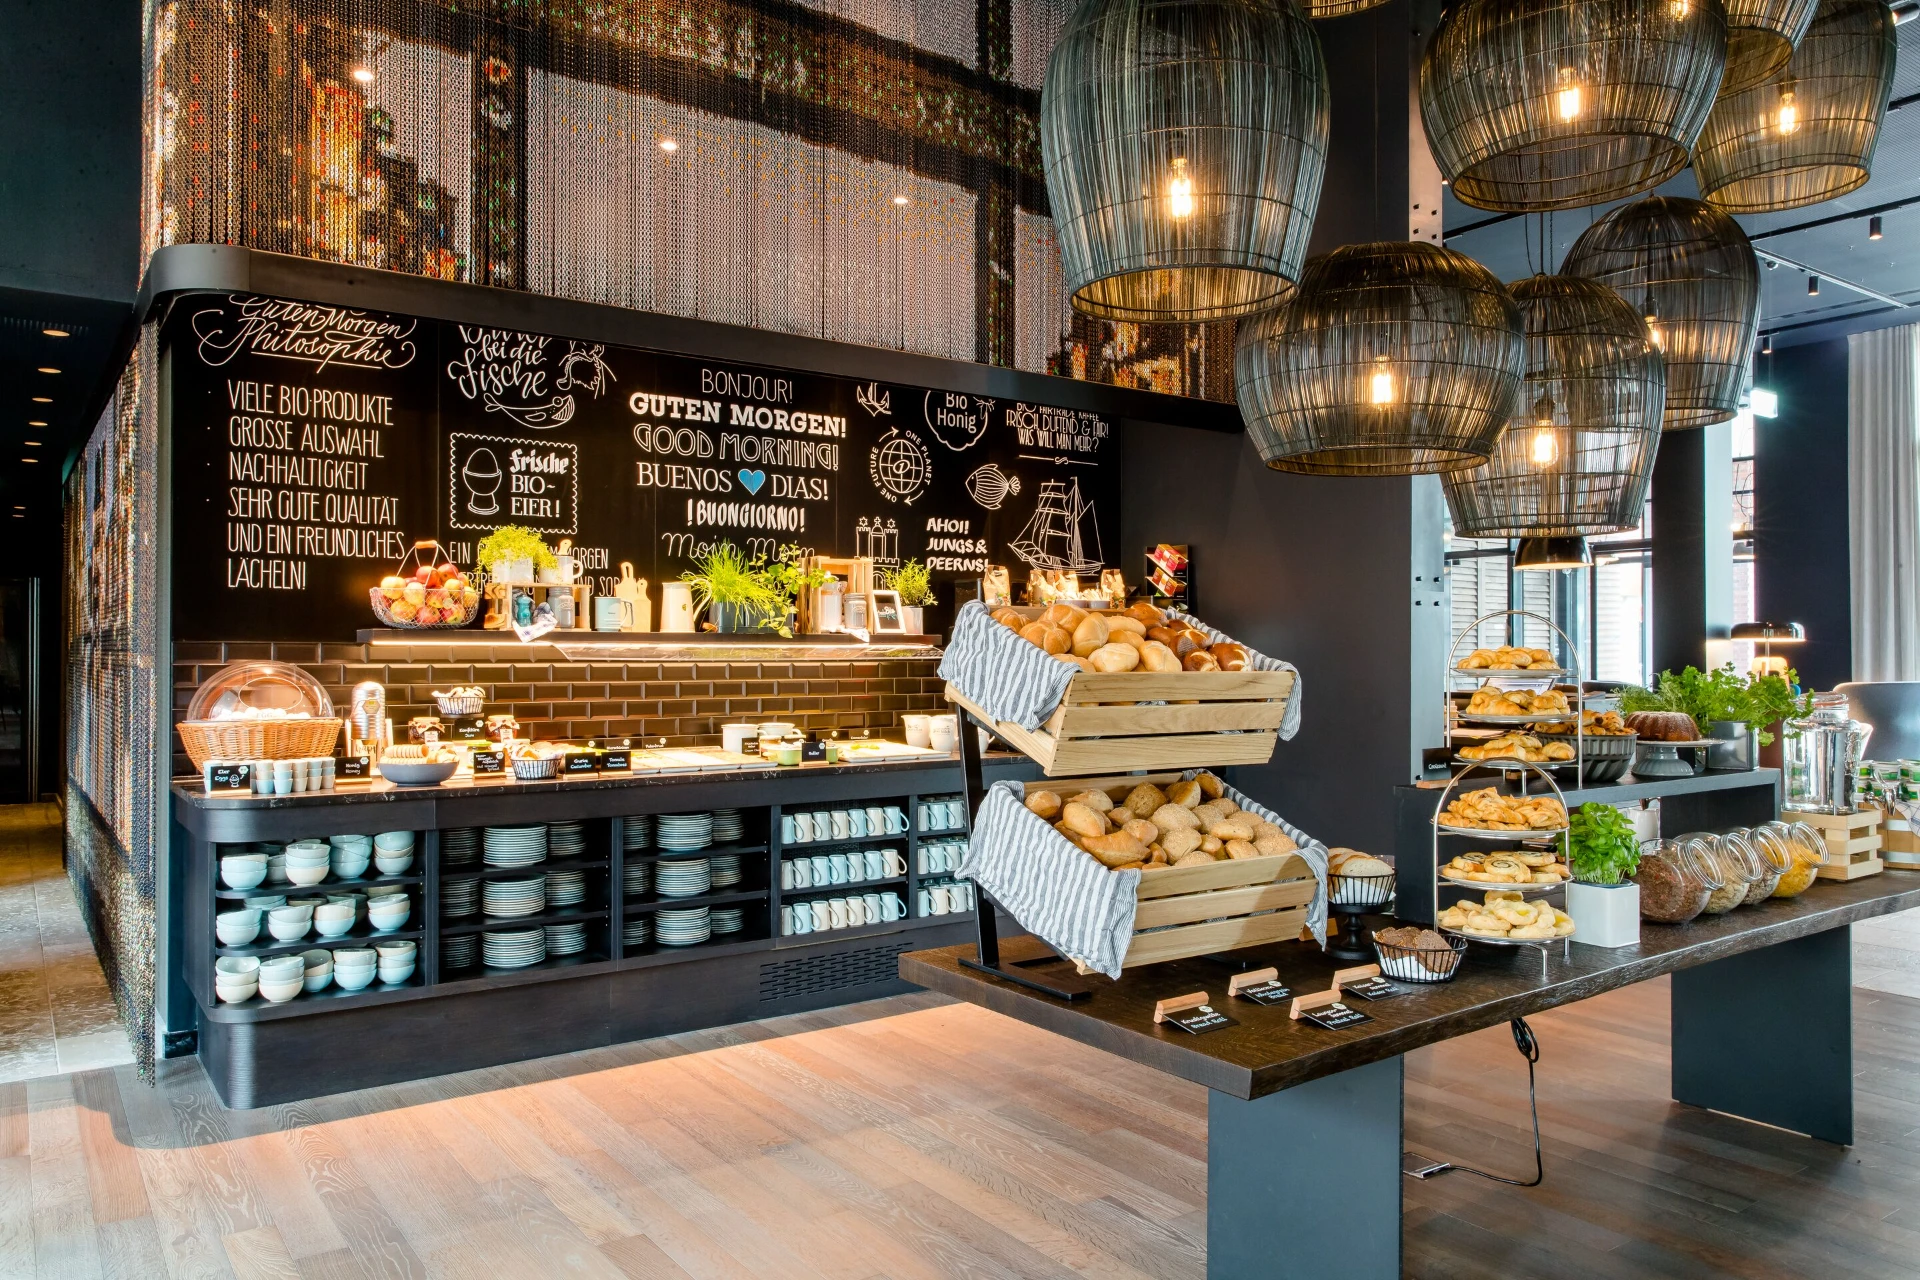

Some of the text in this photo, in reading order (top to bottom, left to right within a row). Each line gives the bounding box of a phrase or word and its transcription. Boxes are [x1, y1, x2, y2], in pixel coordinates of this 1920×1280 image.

[237, 296, 408, 340] Guten Morgen
[218, 313, 405, 374] Philosophie
[477, 334, 507, 361] bei
[509, 341, 547, 365] die
[447, 347, 548, 400] Fische
[701, 368, 793, 404] BONJOUR!
[227, 378, 275, 414] VIELE
[629, 391, 847, 438] GUTEN MORGEN!
[229, 415, 385, 459] GROSSE AUSWAHL
[937, 407, 977, 434] Honig
[1016, 427, 1035, 446] WAS
[1036, 430, 1055, 449] WILL
[1042, 414, 1079, 435] DUFTEND
[1081, 420, 1091, 436] &
[1092, 421, 1109, 439] FAIR!
[633, 422, 840, 471] GOOD MORNING!
[905, 430, 932, 486] ONE PLANET
[229, 451, 369, 491] NACHHALTIGKEIT
[636, 461, 830, 501] BUENOS DIAS!
[869, 446, 897, 503] ONE FUTURE
[227, 486, 399, 526] SEHR GUTE QUALITÄT
[227, 522, 405, 560] UND EIN FREUNDLICHES
[926, 517, 970, 535] AHOI!
[450, 541, 471, 564] EIN
[660, 532, 739, 562] Moin
[926, 556, 989, 573] DEERNS!
[227, 557, 306, 590] LÄCHELN!
